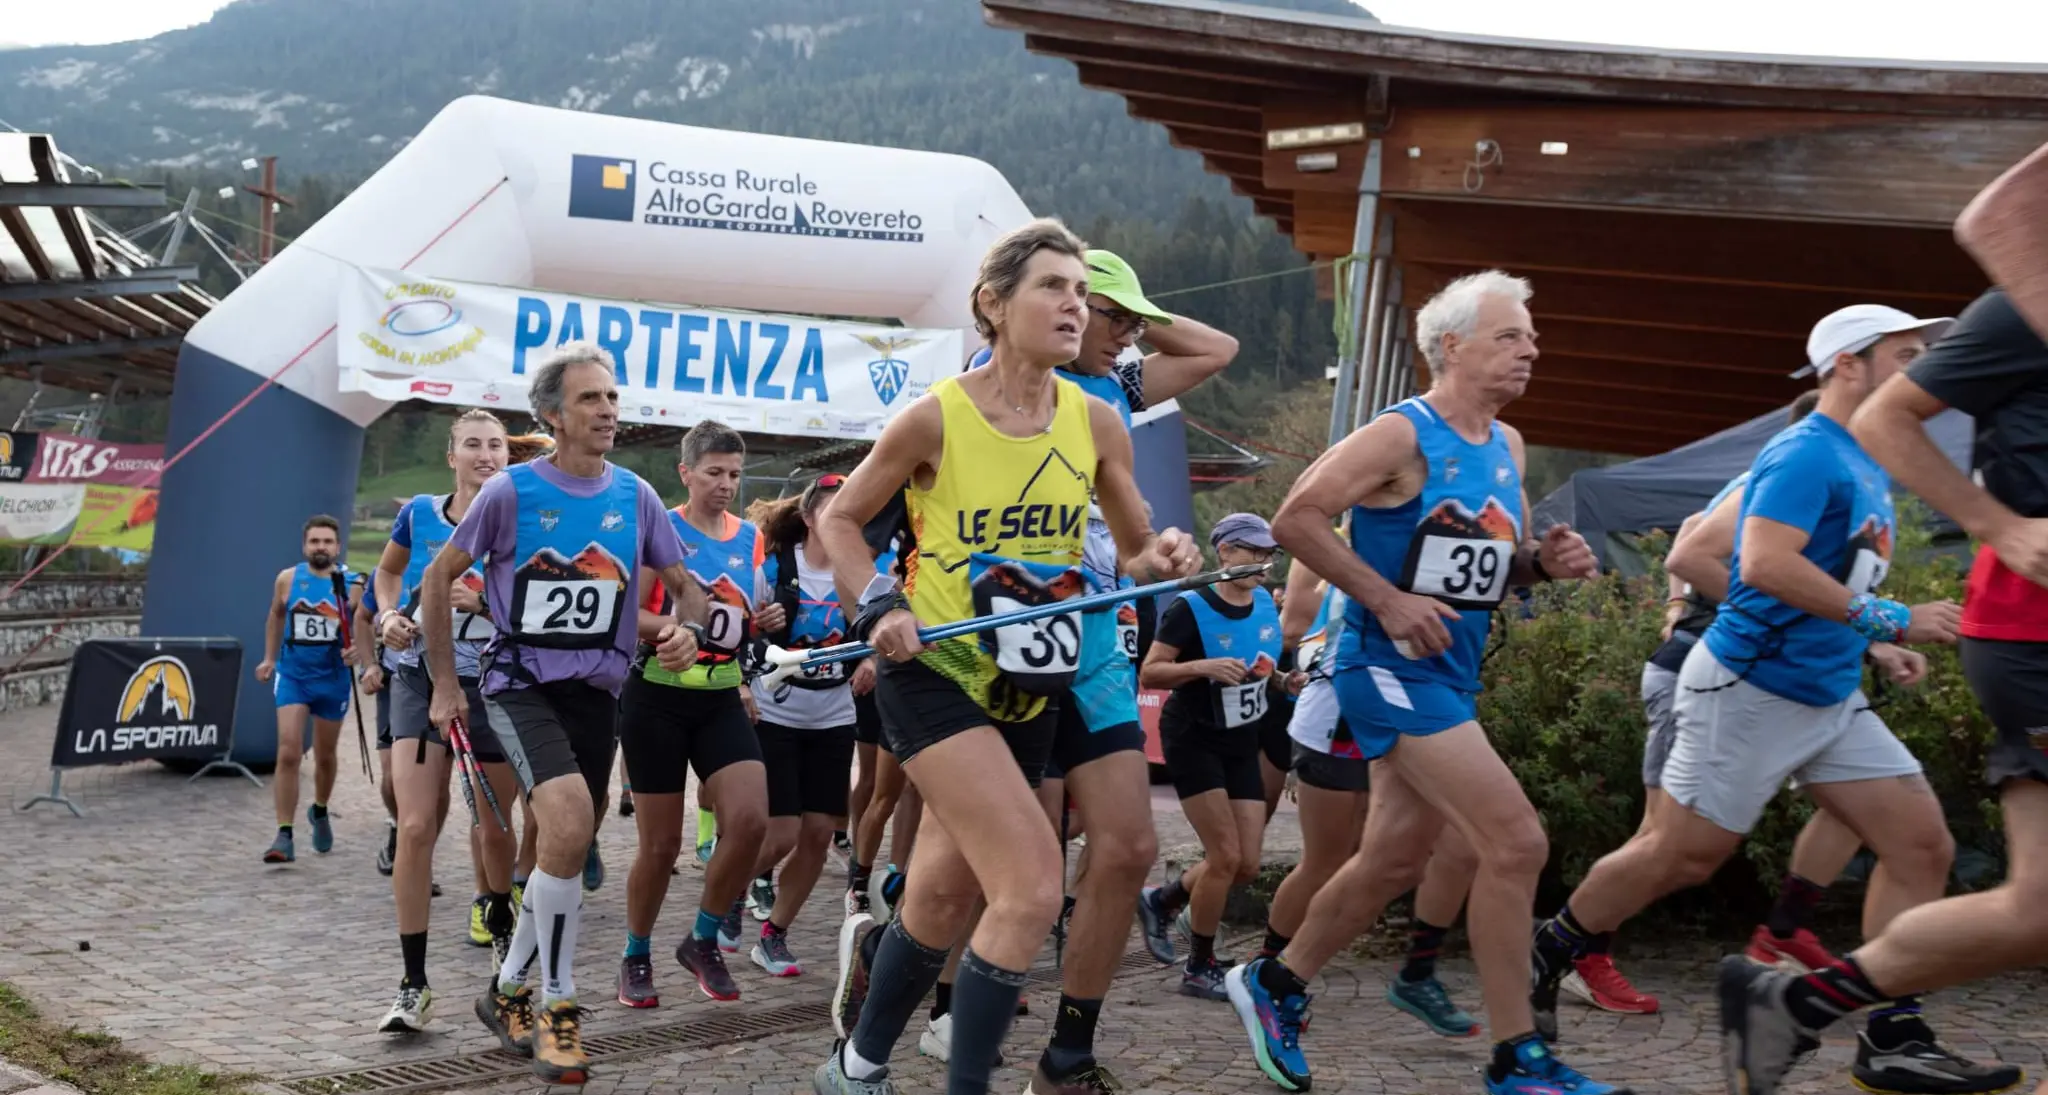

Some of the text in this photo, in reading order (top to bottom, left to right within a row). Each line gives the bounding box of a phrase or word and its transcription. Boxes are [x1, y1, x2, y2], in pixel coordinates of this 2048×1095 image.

[648, 161, 818, 196] Cassa Rurale
[646, 188, 922, 230] AltoGarda Rovereto
[646, 215, 715, 228] CREDITO
[725, 220, 836, 237] COOPERATIVO
[847, 227, 874, 239] DAL
[512, 297, 829, 402] PARTENZA
[869, 361, 909, 396] SAT
[39, 436, 119, 478] ITAS
[957, 509, 992, 545] LE
[1443, 545, 1498, 597] 39
[543, 586, 600, 630] 29
[305, 617, 328, 639] 61
[1020, 613, 1080, 668] 30
[75, 724, 217, 753] LA SPORTIVA
